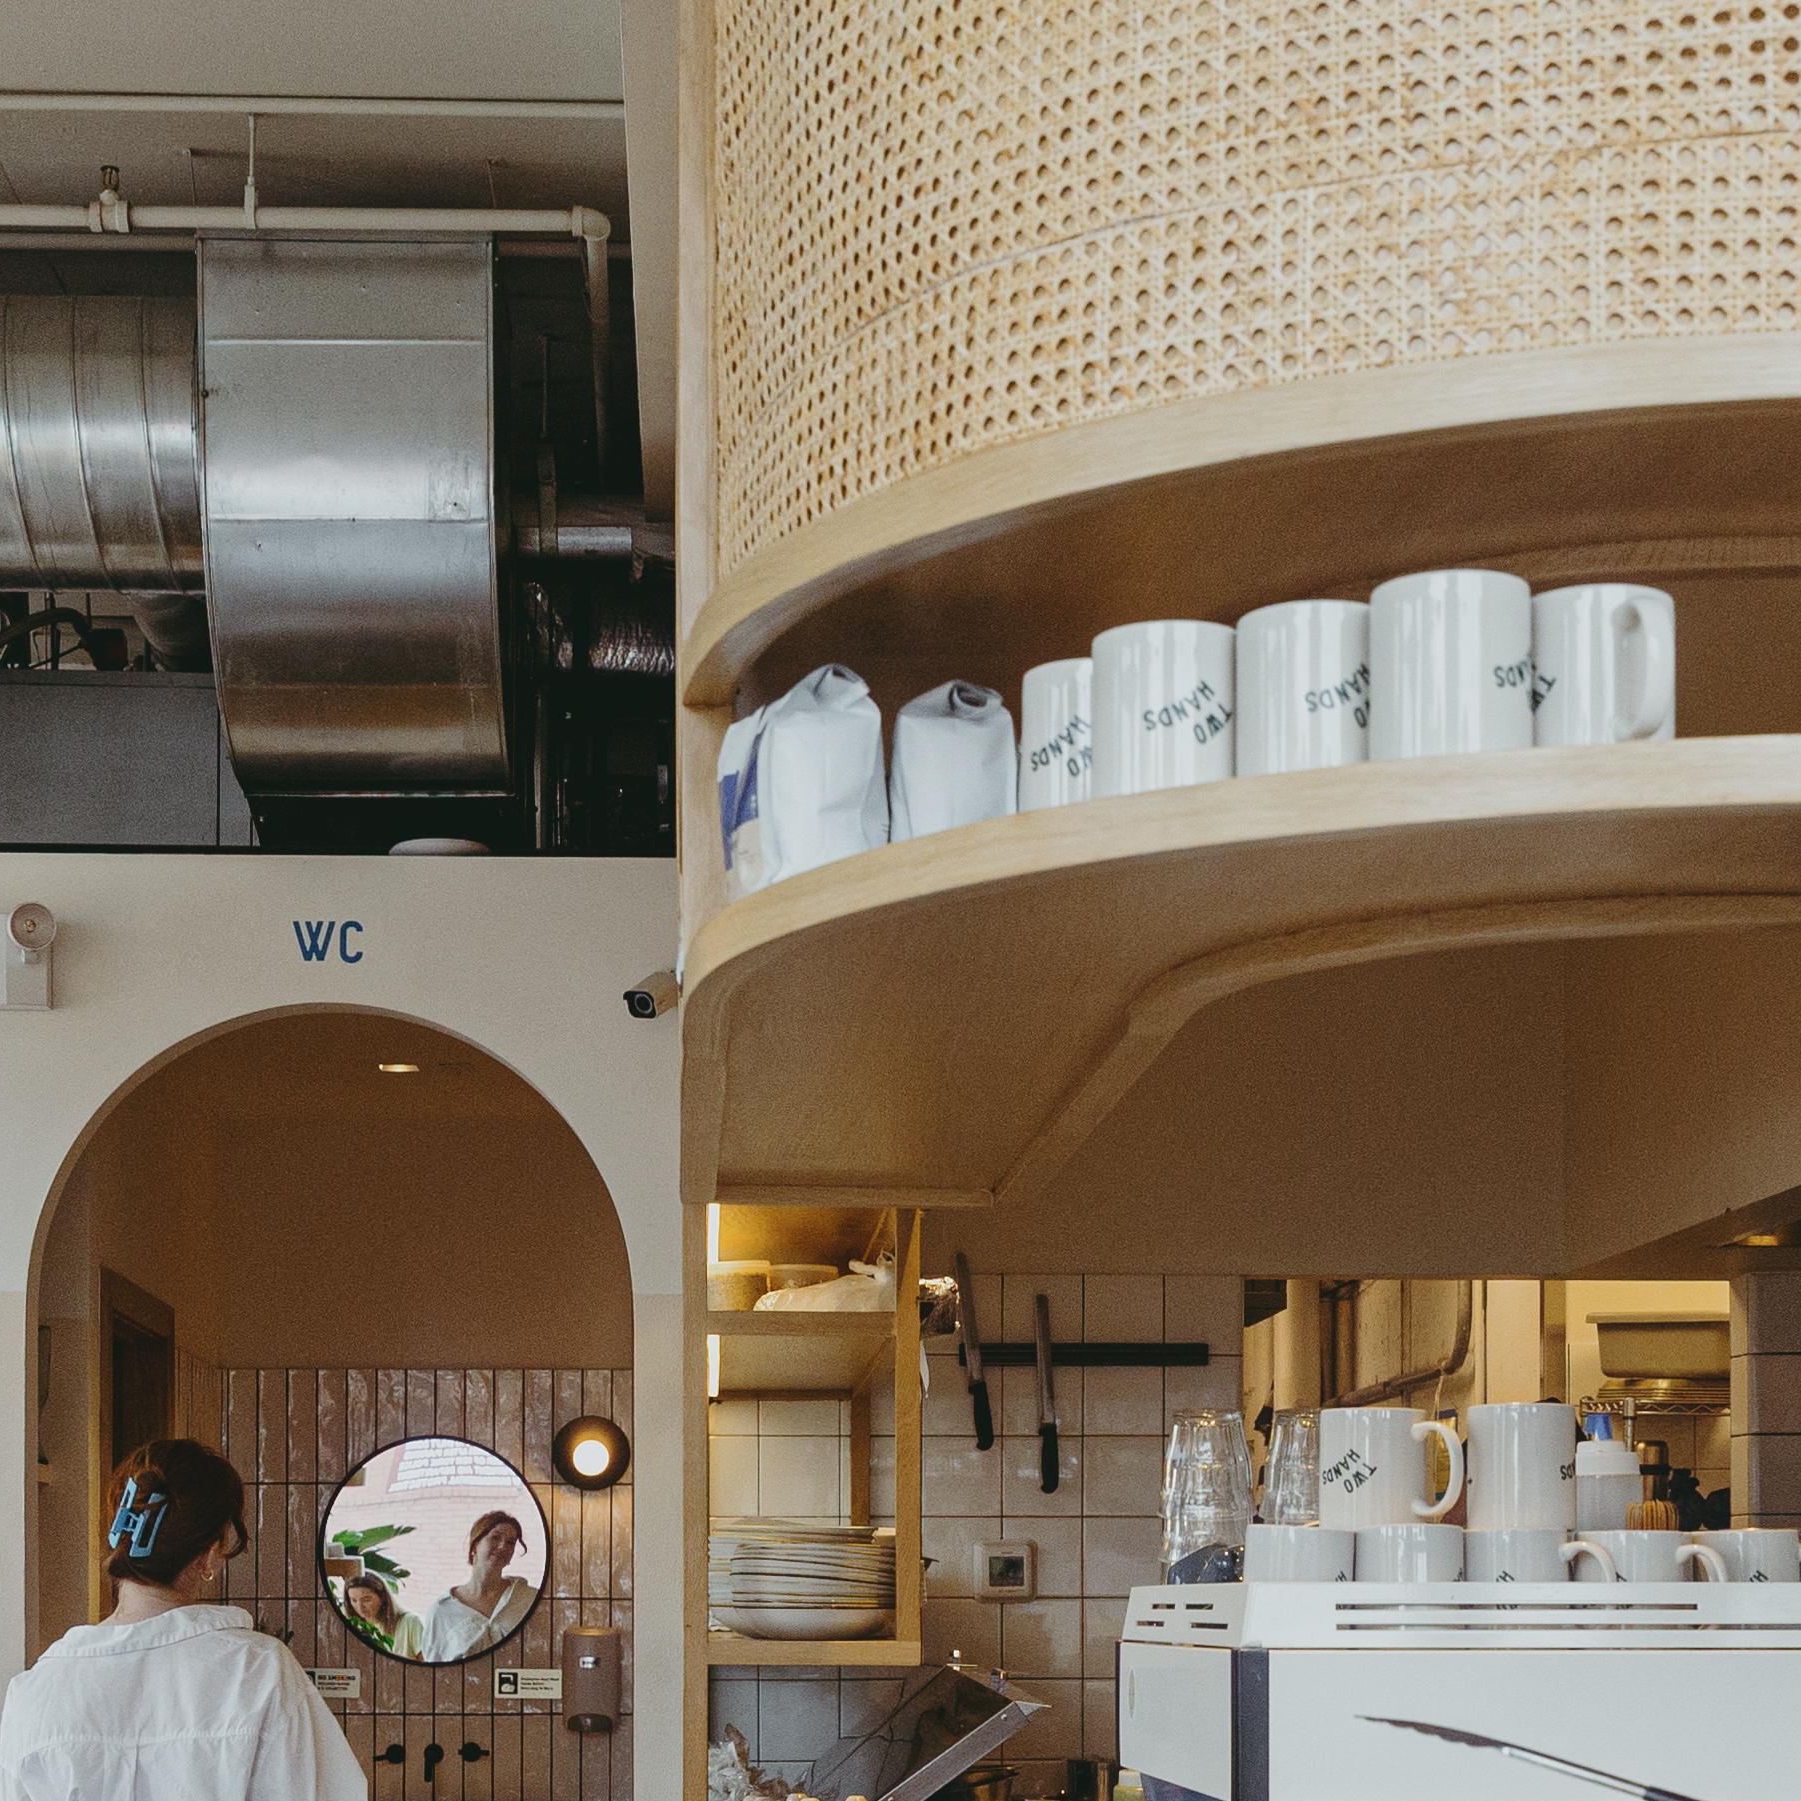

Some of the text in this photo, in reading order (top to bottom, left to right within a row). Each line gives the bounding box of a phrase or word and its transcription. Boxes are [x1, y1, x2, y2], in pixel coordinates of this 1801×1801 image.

[1144, 680, 1215, 731] HANDS
[1194, 704, 1233, 744] TWO
[1030, 714, 1091, 772] HANDS
[1066, 744, 1093, 778] WO
[292, 920, 364, 964] WC
[1321, 1448, 1362, 1485] HANDS
[1343, 1461, 1378, 1494] TWO
